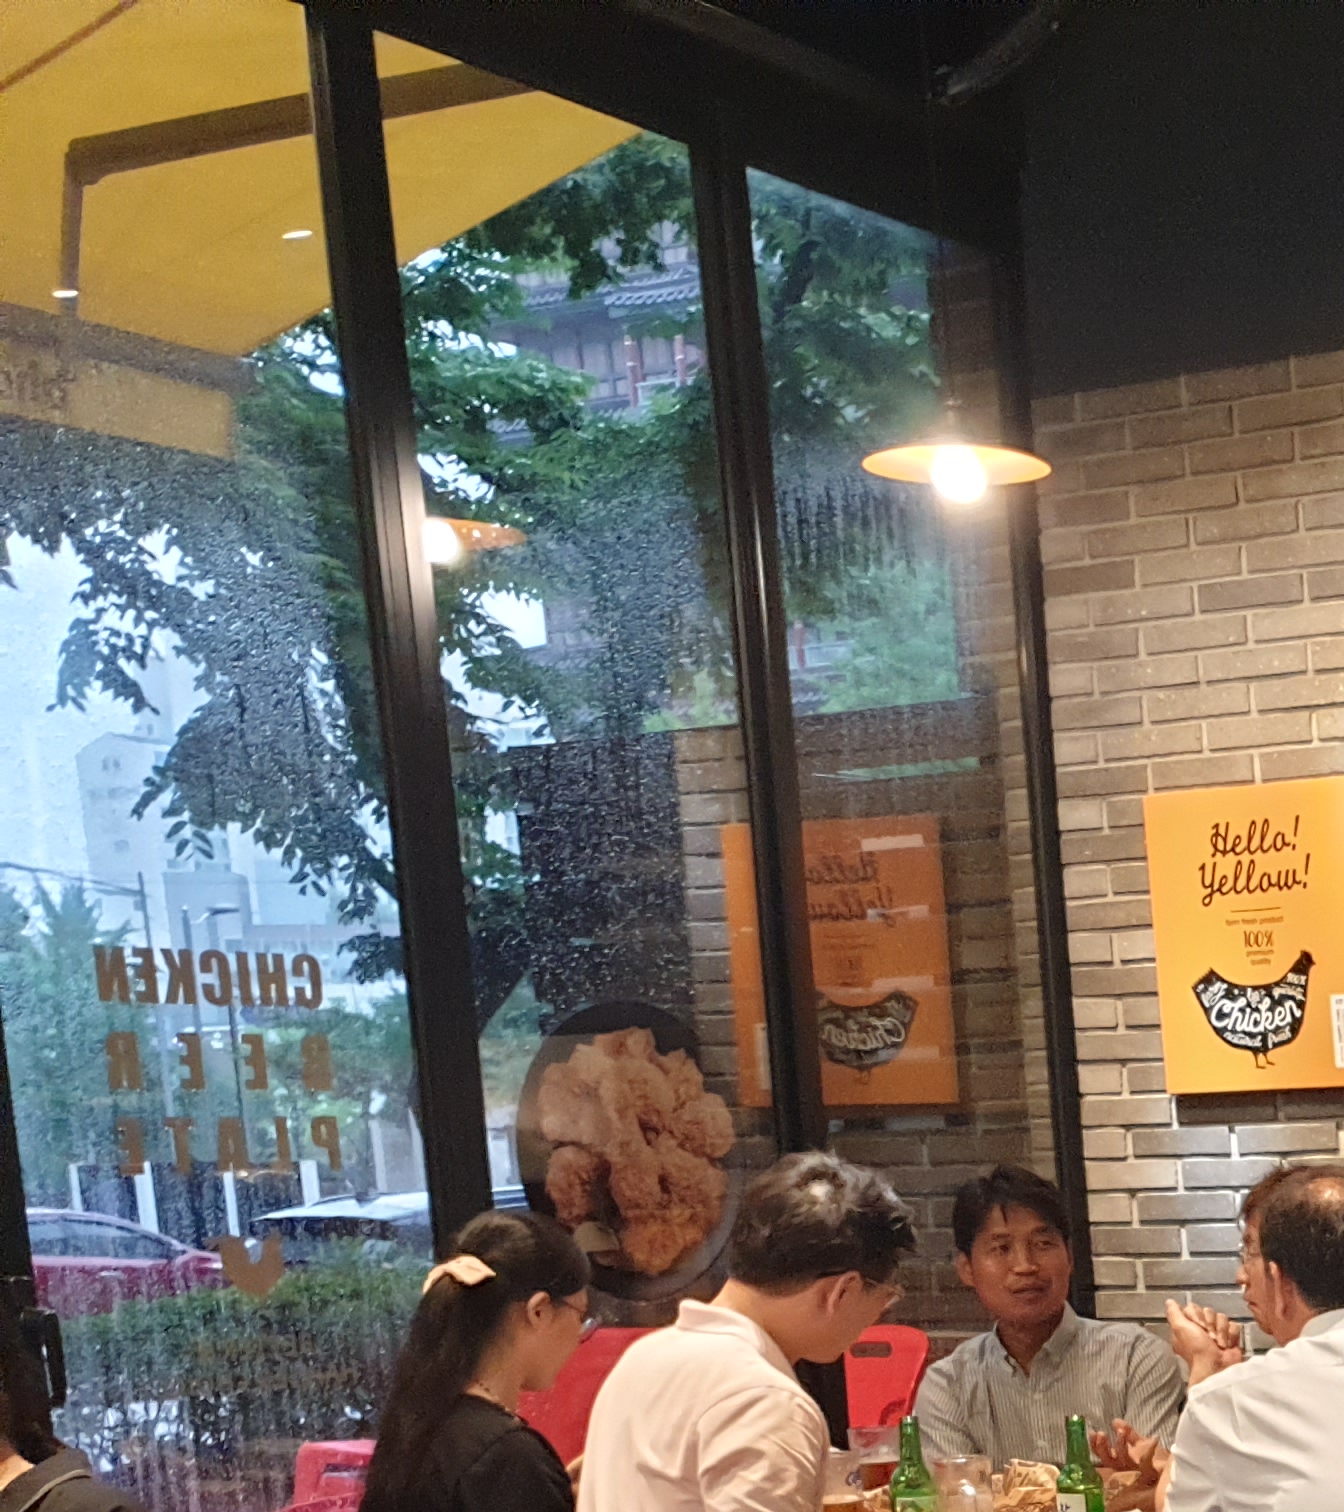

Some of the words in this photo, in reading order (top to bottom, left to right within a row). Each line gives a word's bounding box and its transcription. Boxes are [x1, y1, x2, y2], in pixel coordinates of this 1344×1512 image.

[1210, 814, 1300, 858] Hello!
[1199, 853, 1310, 907] Yellow!
[1210, 997, 1302, 1033] Chicken
